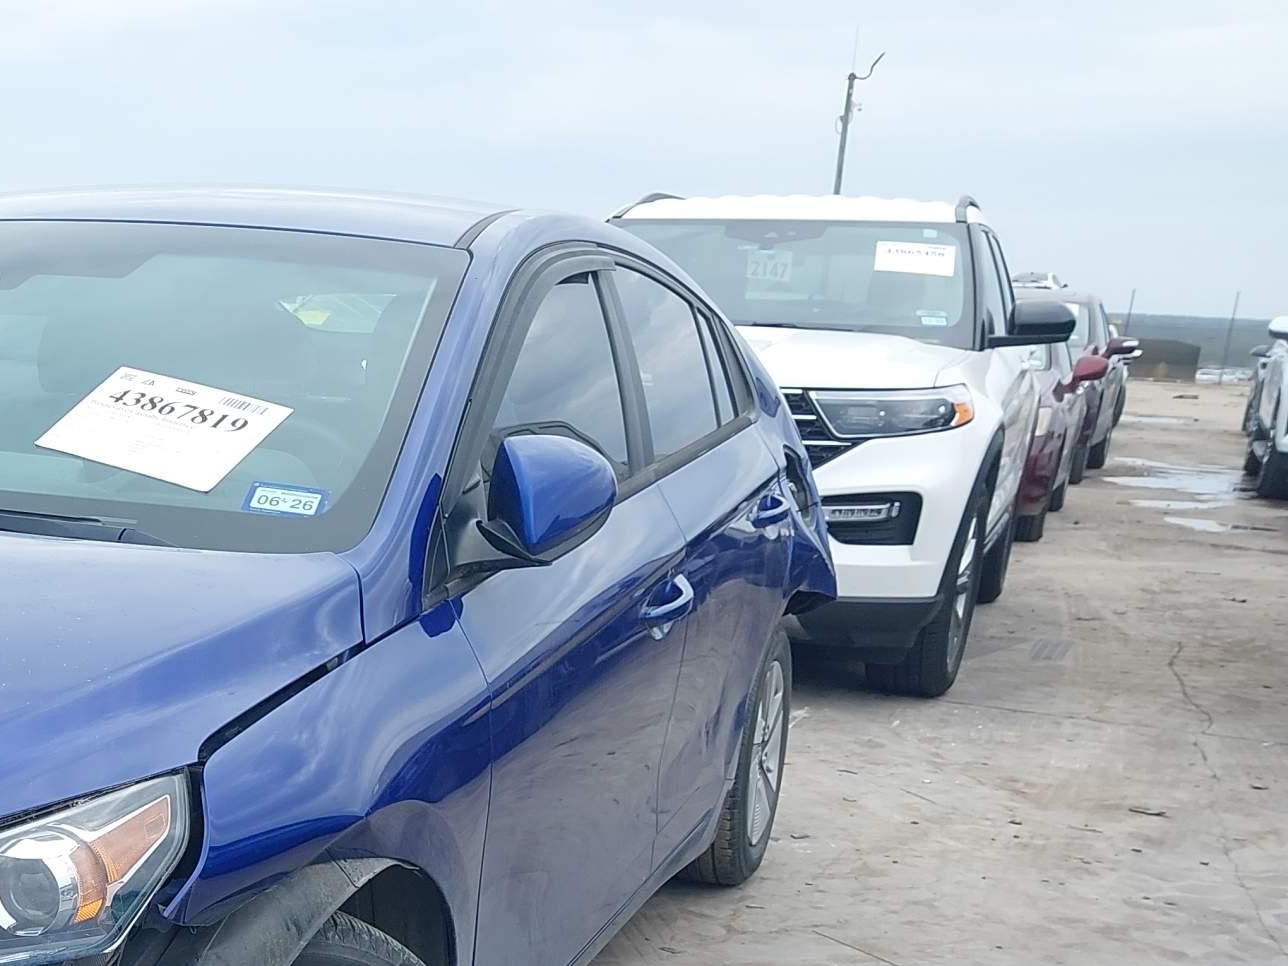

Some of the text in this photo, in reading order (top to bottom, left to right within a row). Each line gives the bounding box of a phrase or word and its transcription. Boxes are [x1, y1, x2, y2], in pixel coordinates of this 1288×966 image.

[109, 389, 249, 432] 43867819
[257, 494, 280, 506] 06
[289, 499, 314, 511] 26
